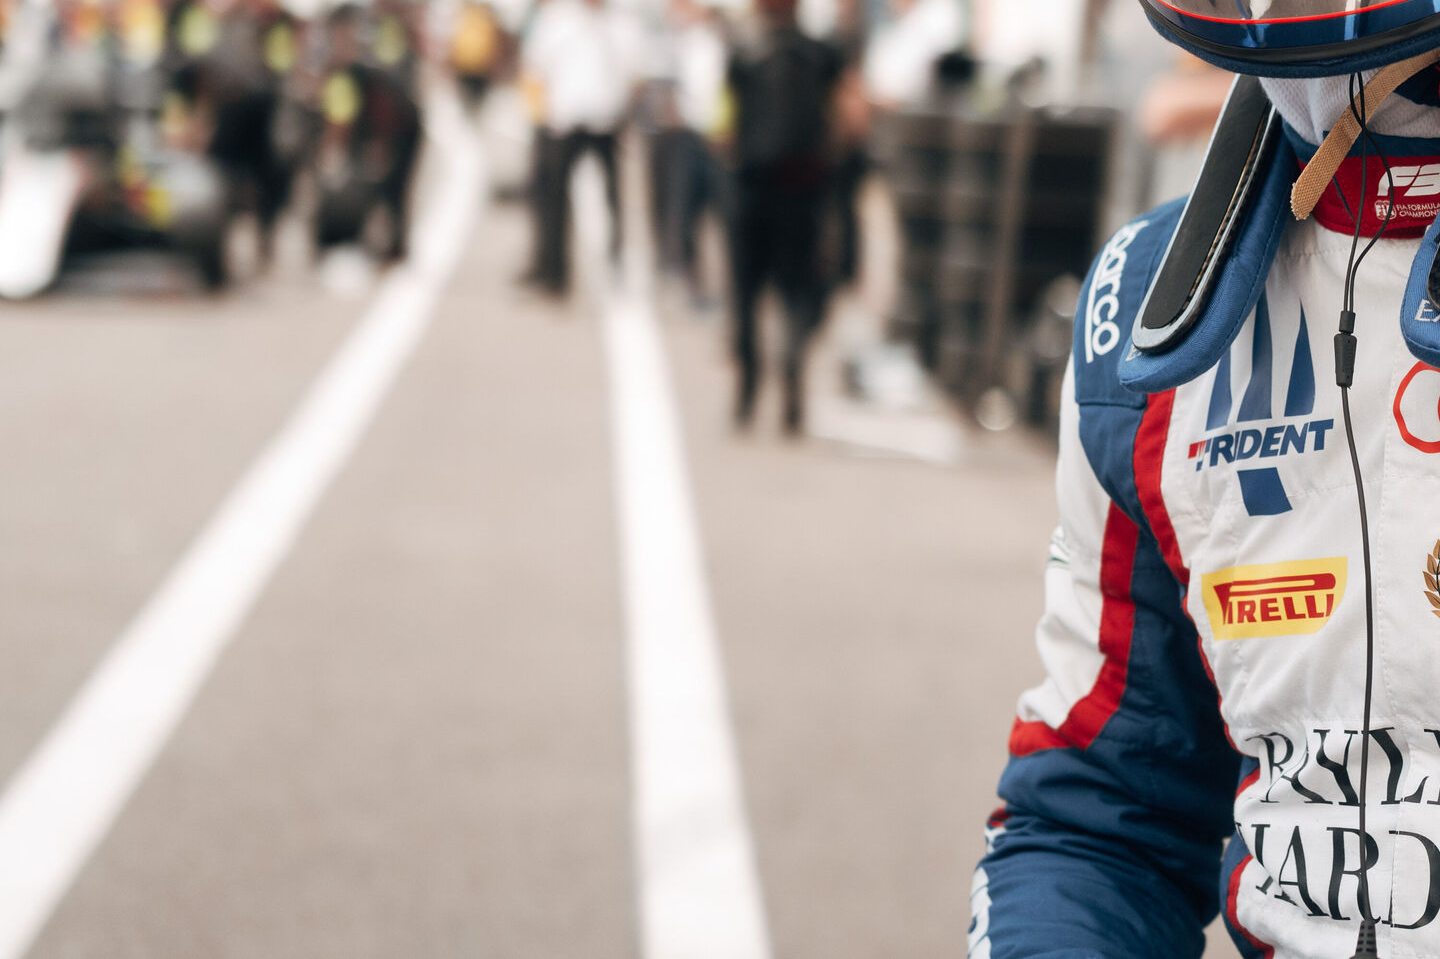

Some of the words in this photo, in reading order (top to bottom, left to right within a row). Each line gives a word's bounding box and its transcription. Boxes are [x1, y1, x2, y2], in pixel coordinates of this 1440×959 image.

[1408, 202, 1440, 212] FORMULA
[1085, 220, 1149, 363] parco
[1188, 419, 1334, 471] TRIDENT
[1213, 573, 1336, 625] PIRELLI
